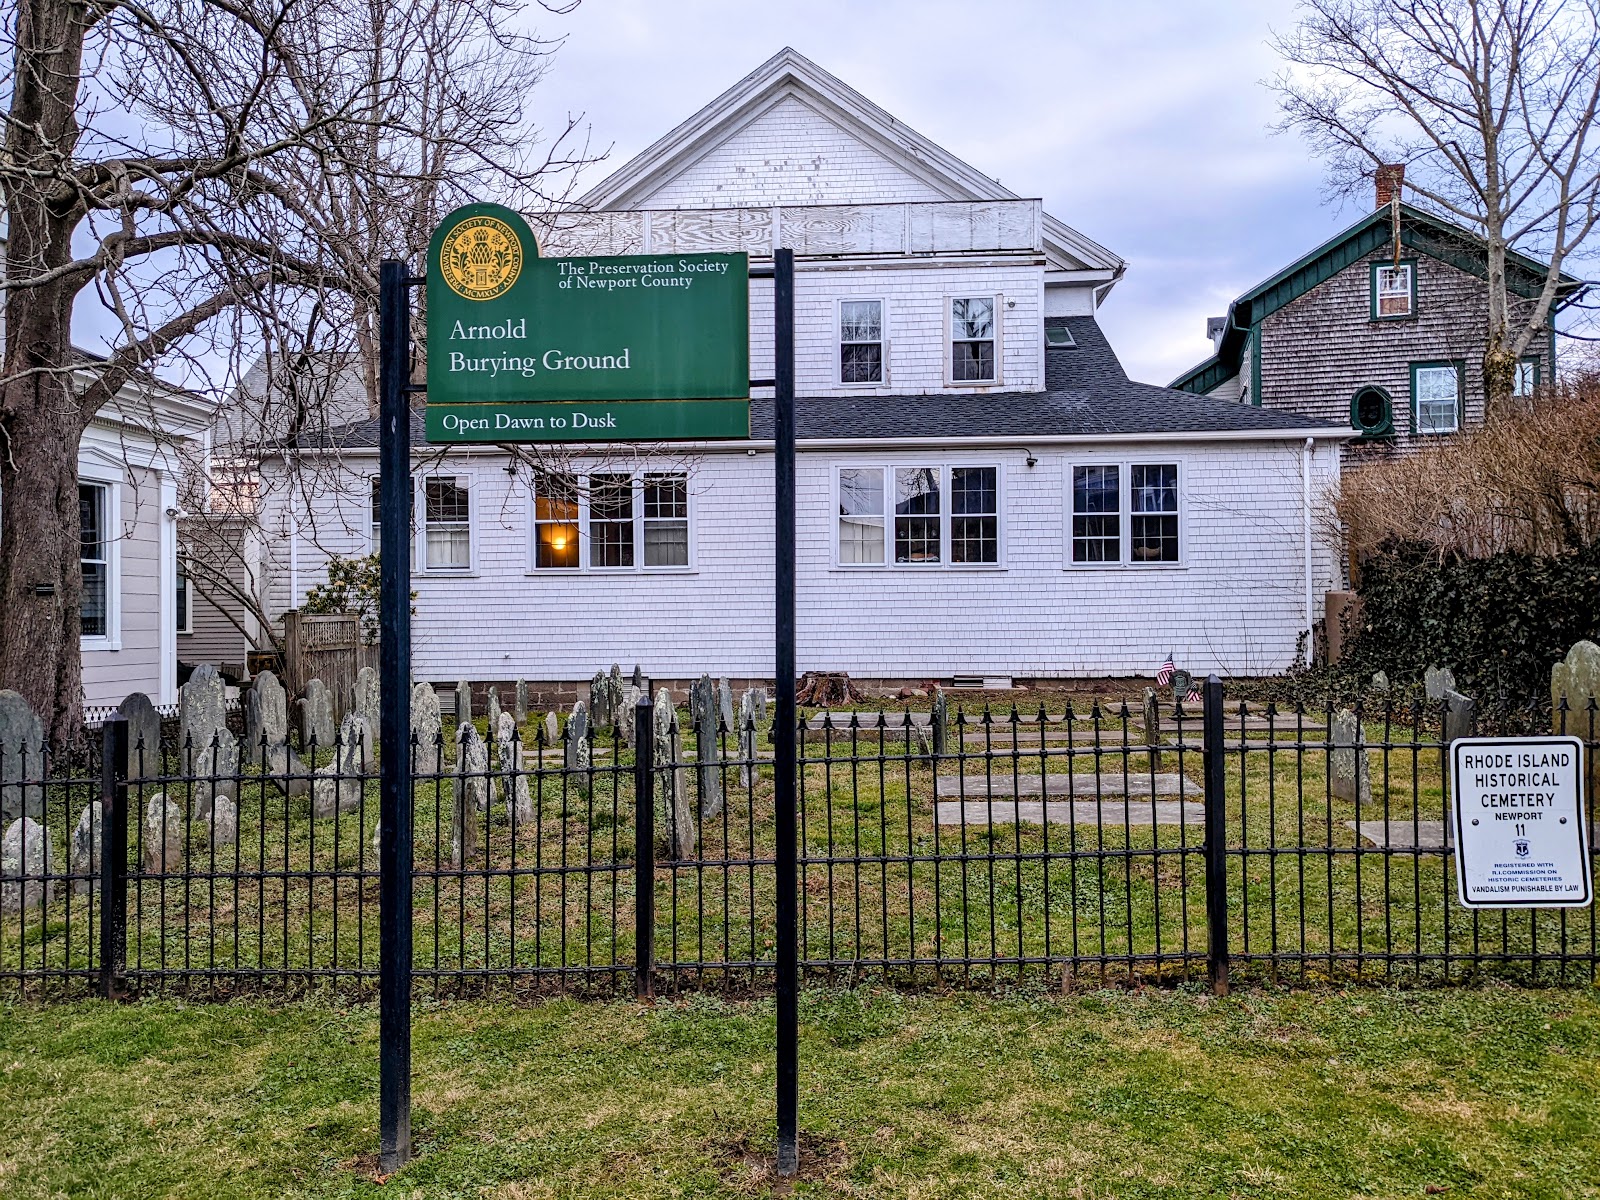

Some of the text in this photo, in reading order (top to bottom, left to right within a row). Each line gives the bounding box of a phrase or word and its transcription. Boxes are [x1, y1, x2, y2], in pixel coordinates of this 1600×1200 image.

[443, 219, 520, 289] PRESERVATION SOCIETY OF NEWPORT COUNTY
[557, 259, 729, 275] The Preservation Society
[558, 274, 693, 291] of Newport County
[463, 288, 499, 298] MCMXLV
[449, 318, 527, 340] Arnold
[449, 348, 630, 379] Burying Ground
[442, 412, 617, 435] Open Dawn to Dusk
[1465, 753, 1570, 769] RHODE ISLAND
[1475, 773, 1560, 788] HISTORICAL
[1481, 793, 1555, 808] CEMETERY
[1495, 812, 1543, 821] NEWPORT
[1515, 823, 1526, 837] 11
[1472, 885, 1510, 893] VANDALISM
[1555, 884, 1564, 892] BY
[1565, 884, 1579, 892] LAW
